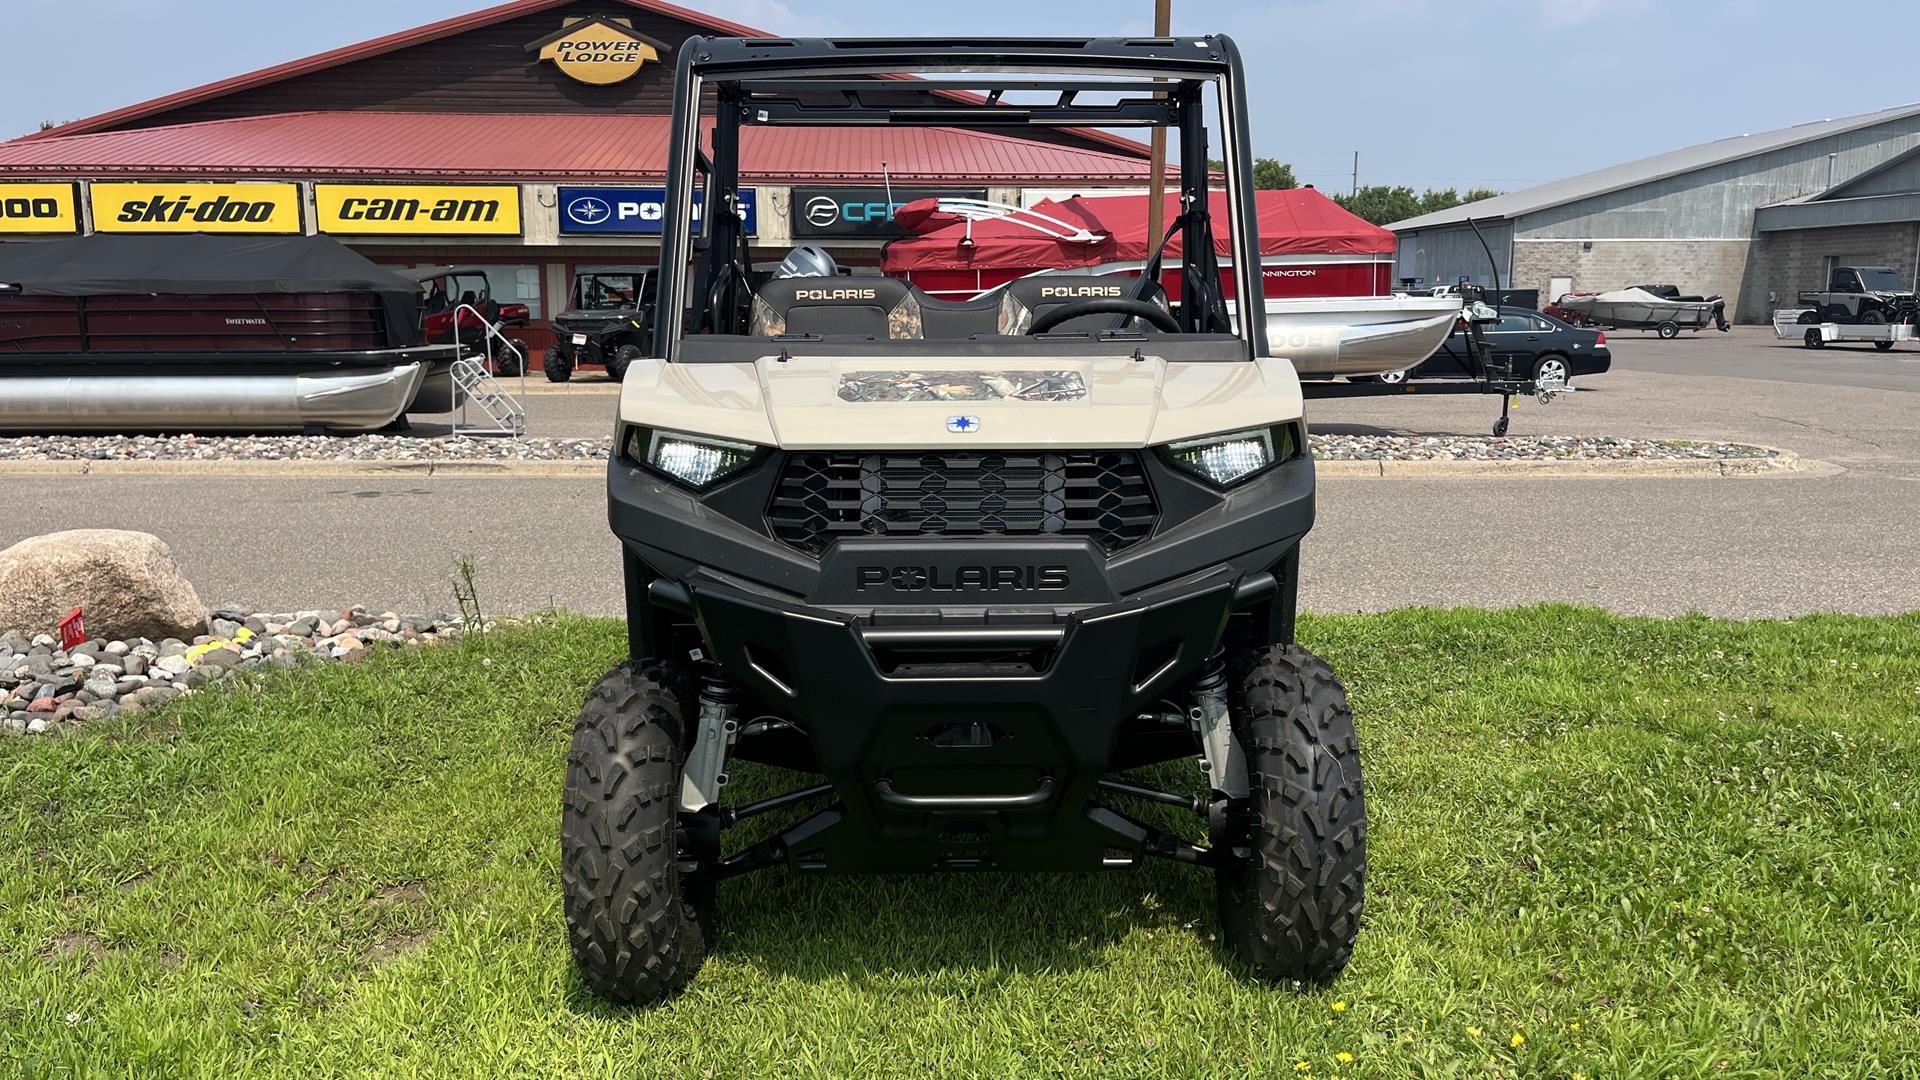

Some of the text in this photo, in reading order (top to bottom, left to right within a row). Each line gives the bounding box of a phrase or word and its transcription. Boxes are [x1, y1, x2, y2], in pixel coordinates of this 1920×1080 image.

[556, 41, 641, 53] POWER
[562, 51, 638, 62] LODGE
[117, 195, 275, 222] ski-doo
[339, 198, 499, 222] can-am
[796, 289, 876, 300] POLARIS
[1041, 286, 1121, 297] POLARIS
[856, 565, 1070, 592] POLARIS
